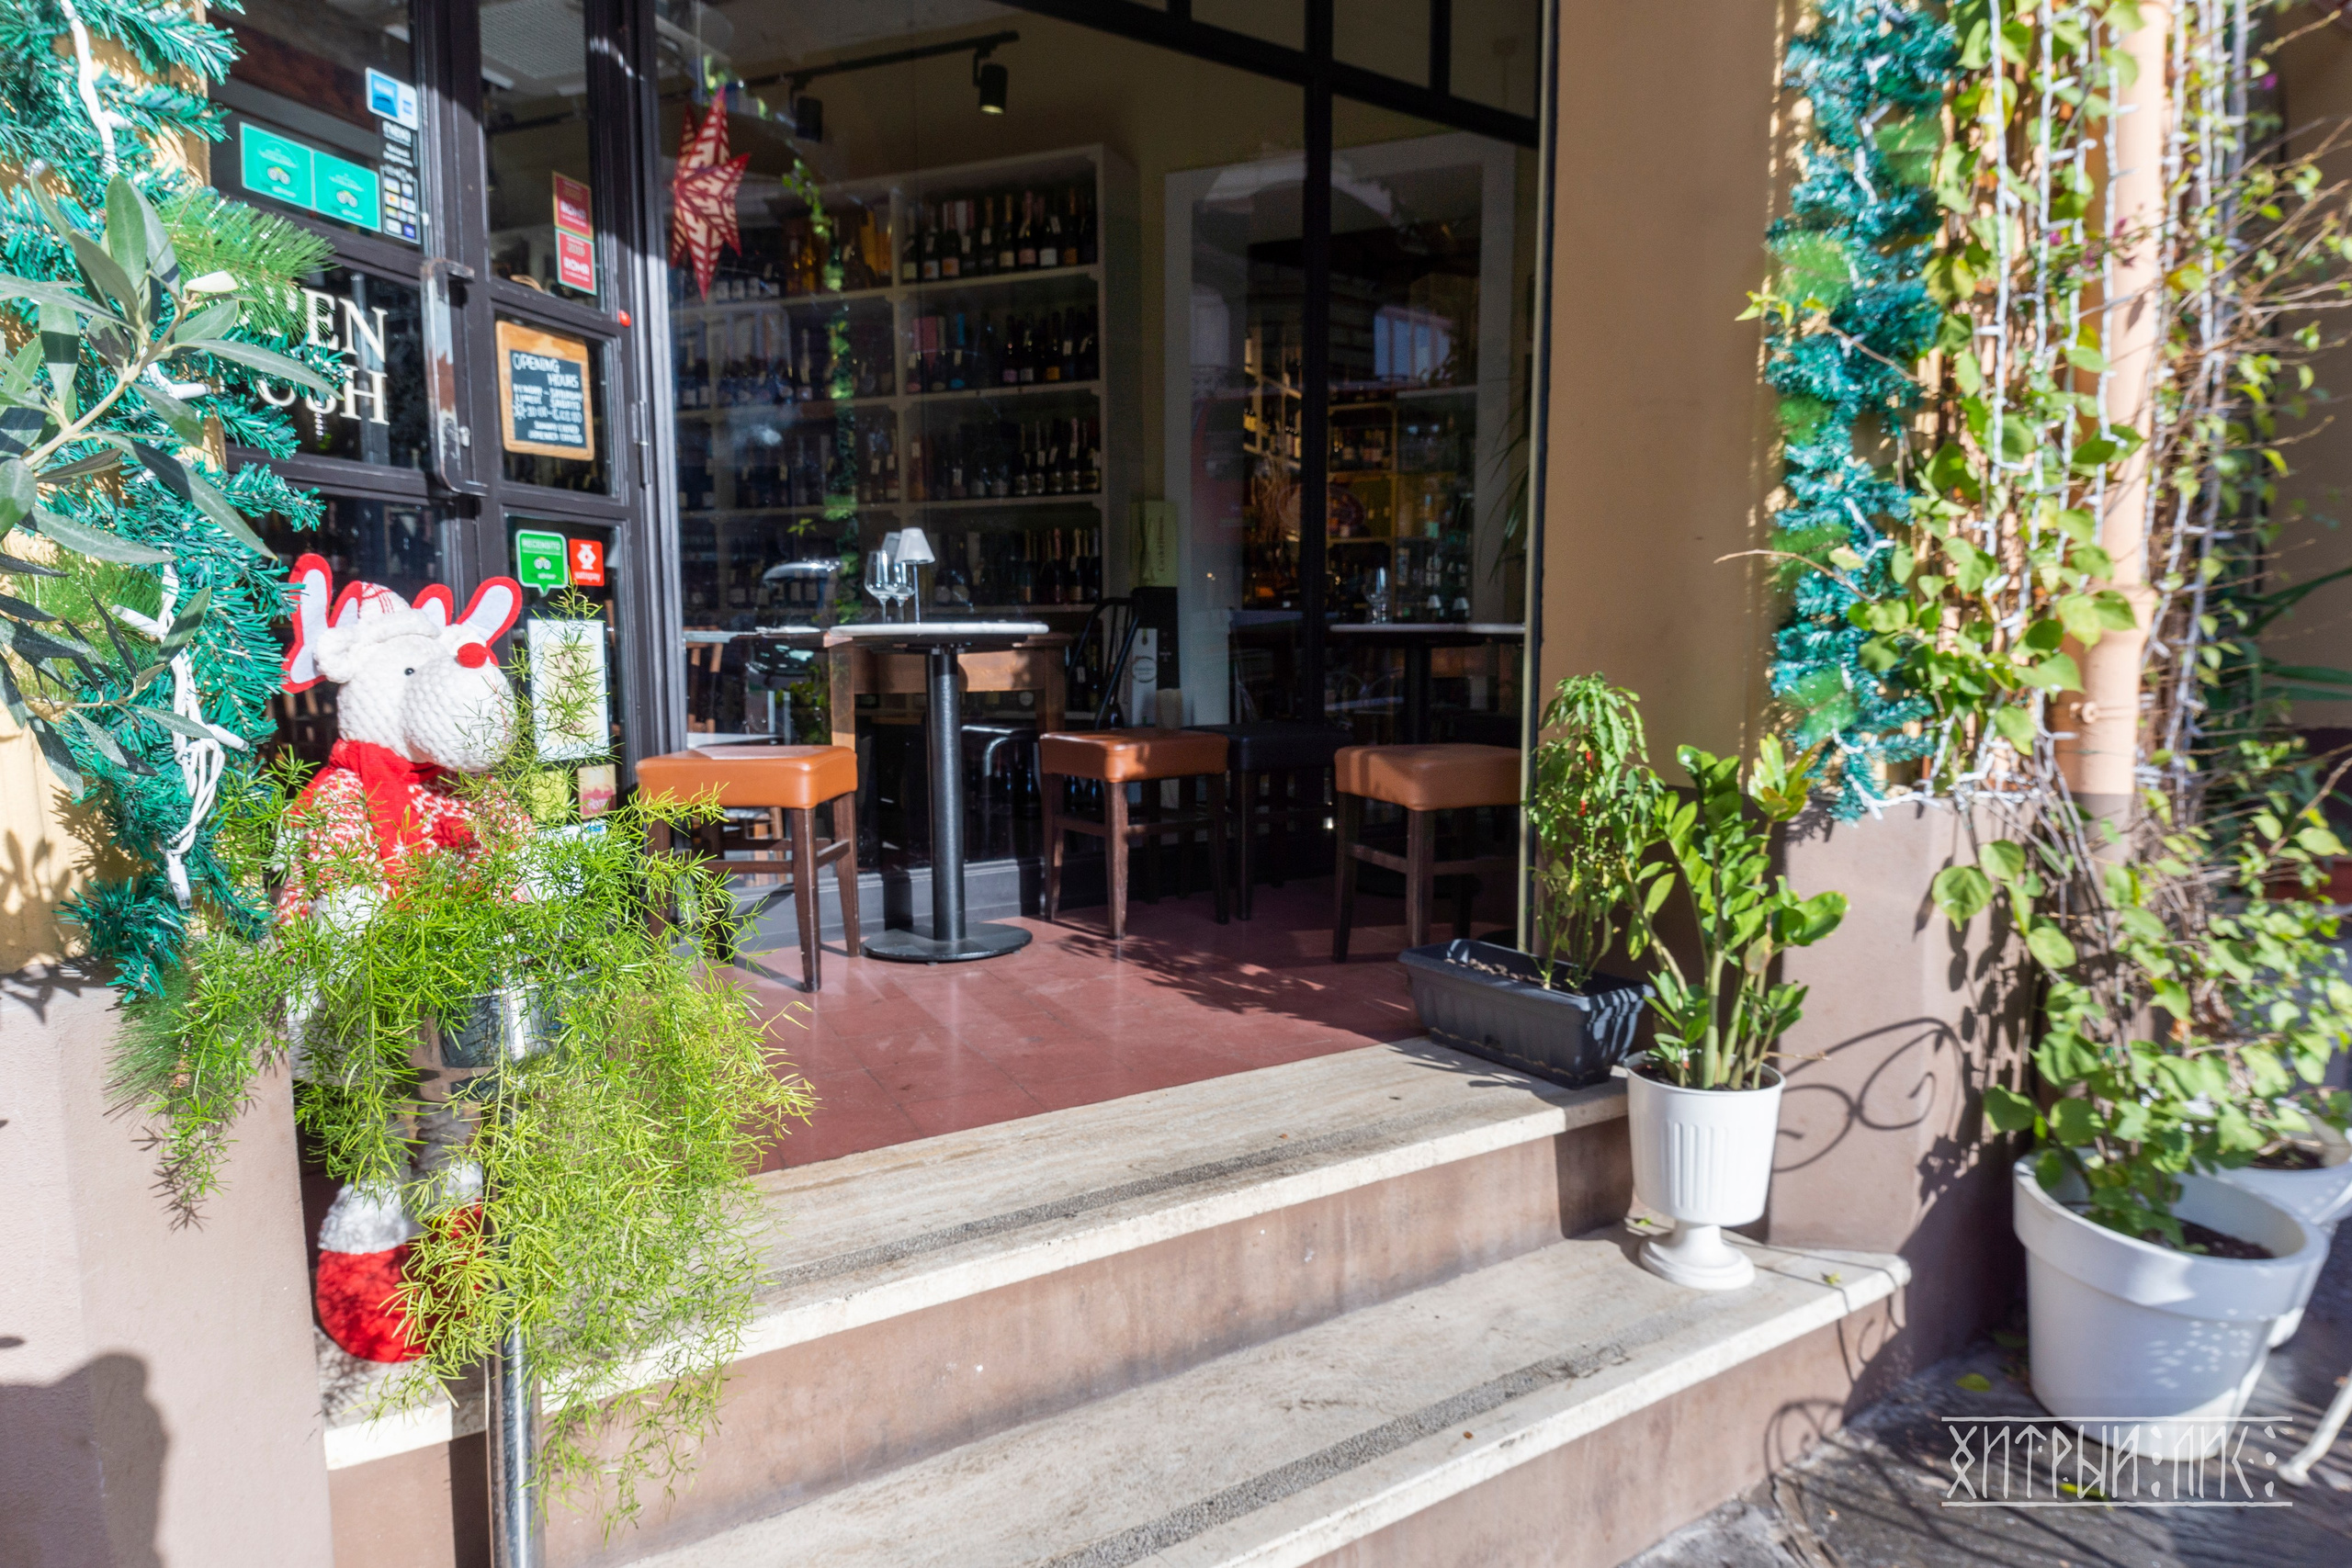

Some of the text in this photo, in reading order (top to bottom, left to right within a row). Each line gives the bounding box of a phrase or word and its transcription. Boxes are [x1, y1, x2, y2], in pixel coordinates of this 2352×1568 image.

[563, 257, 590, 276] ROMA
[290, 288, 389, 364] EN
[512, 353, 560, 374] OPENING
[547, 373, 579, 388] HOURS
[521, 537, 561, 551] RECENSITO
